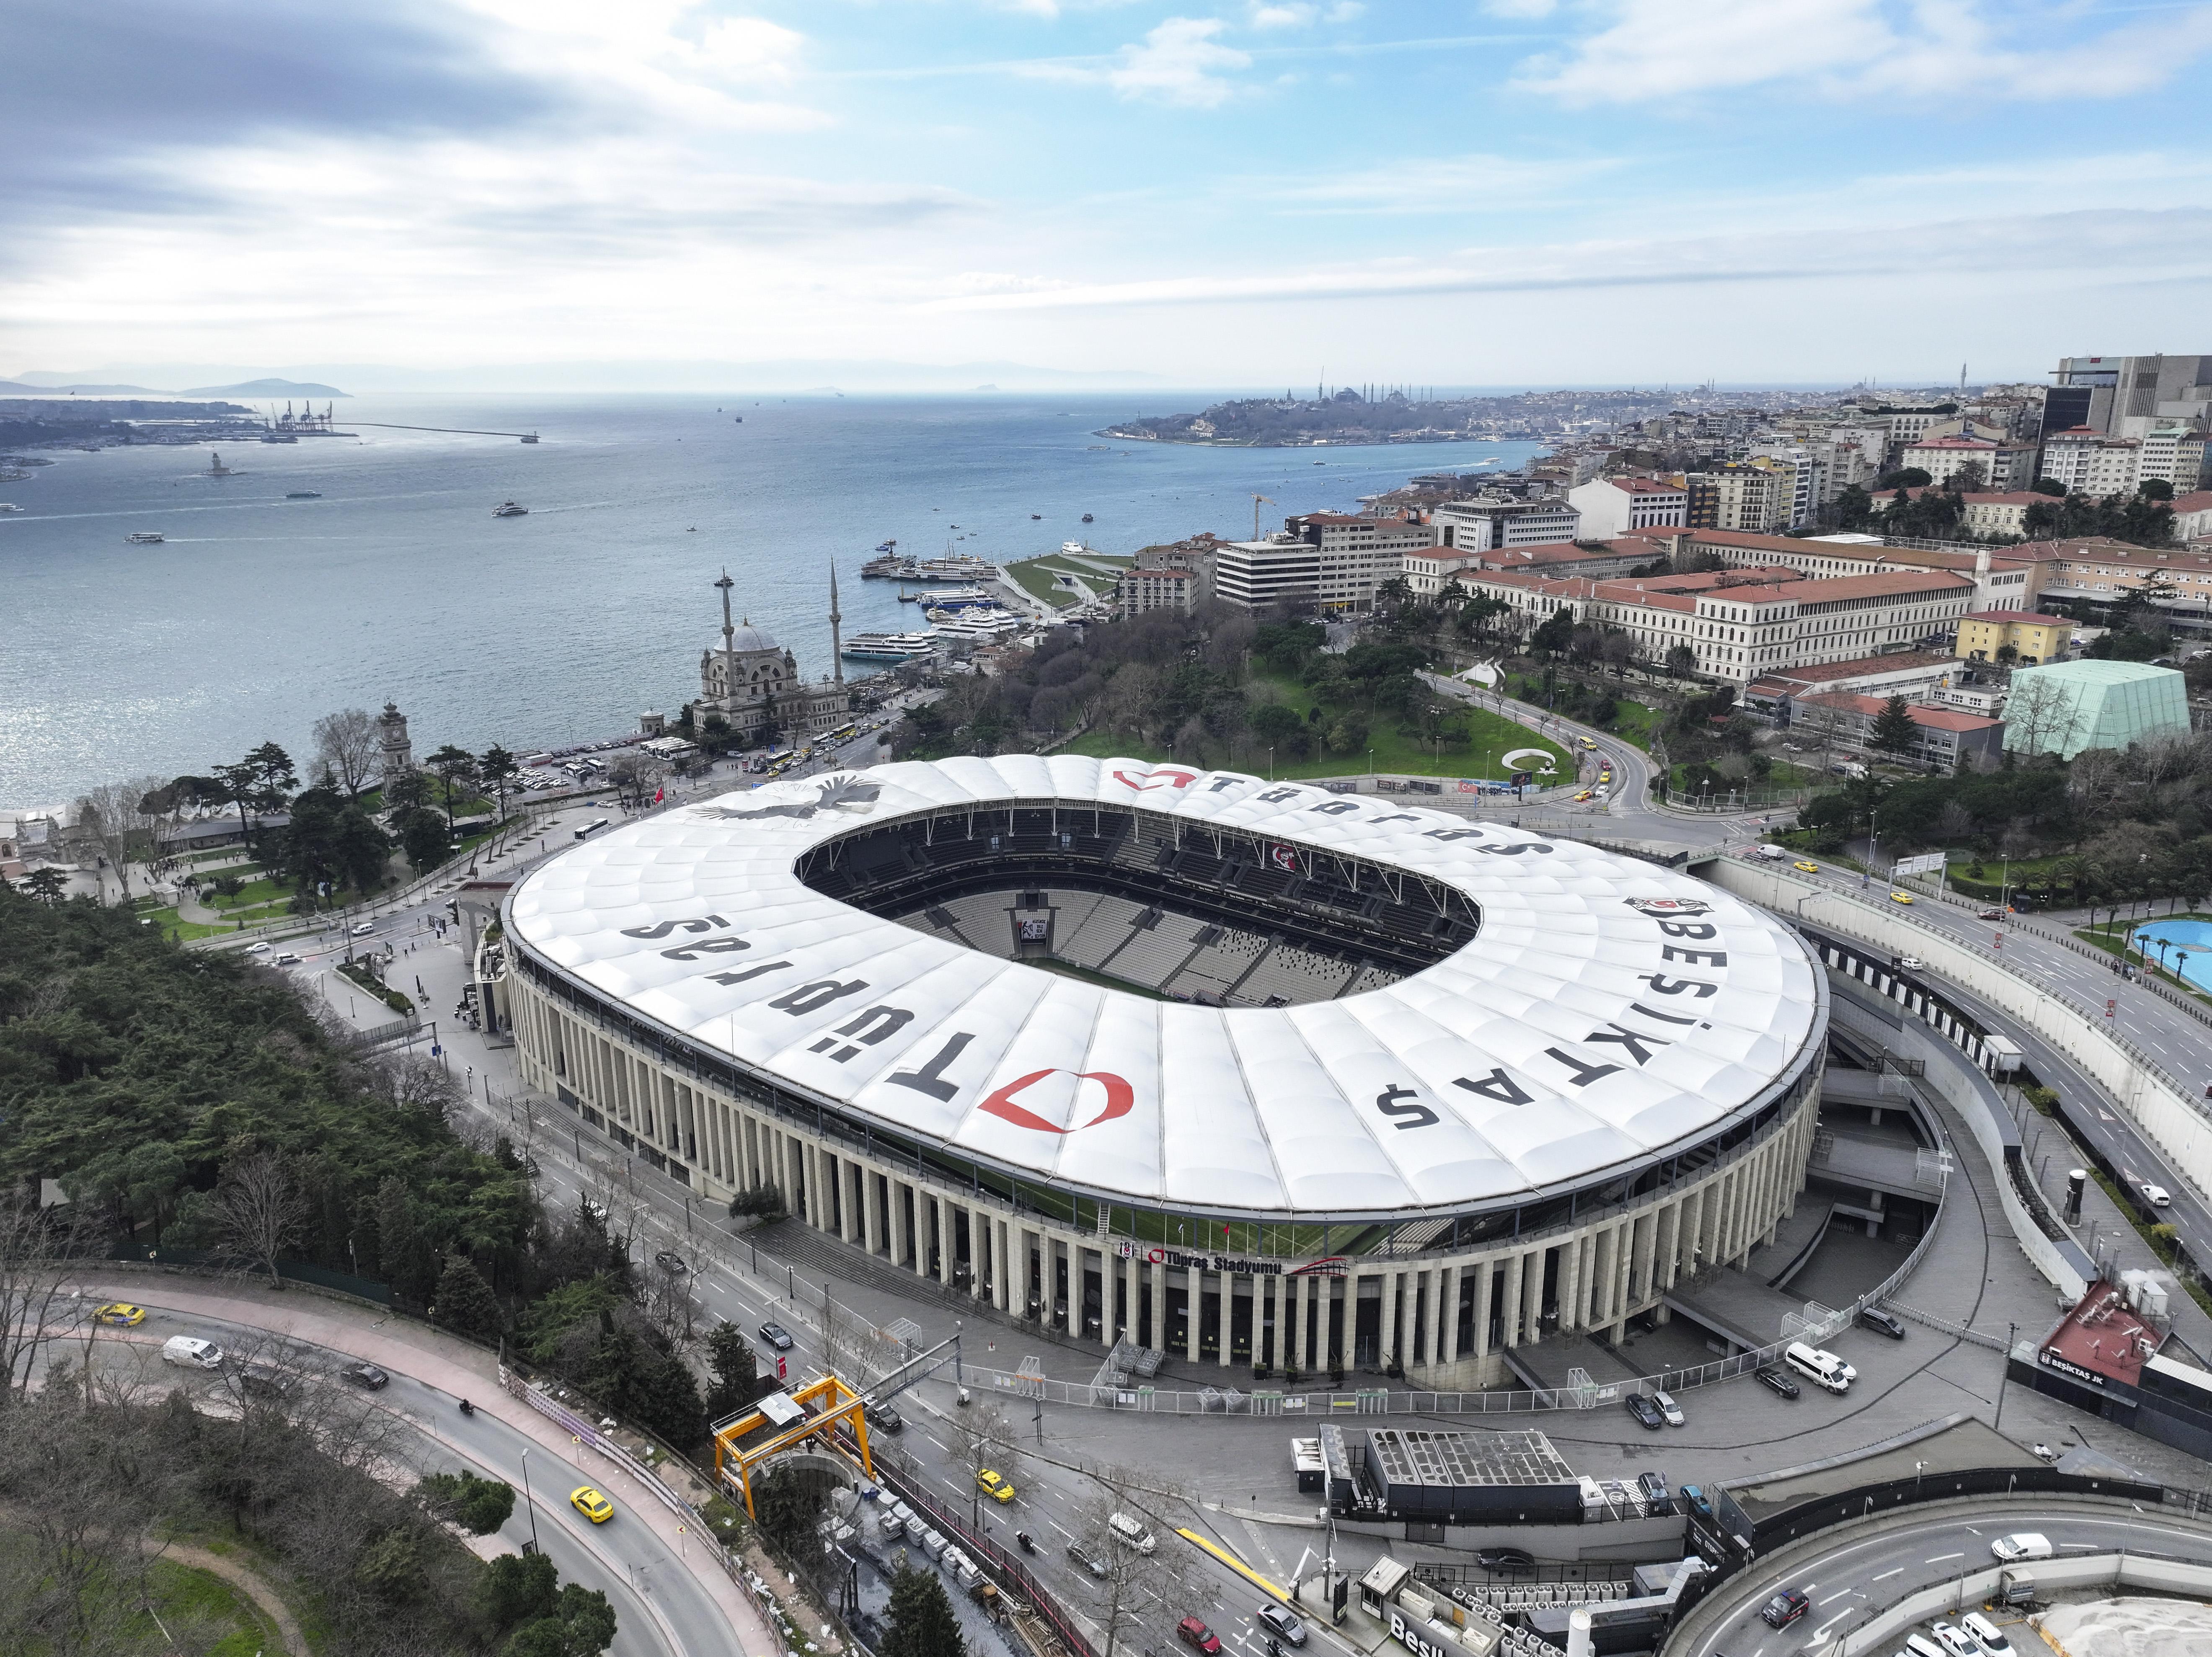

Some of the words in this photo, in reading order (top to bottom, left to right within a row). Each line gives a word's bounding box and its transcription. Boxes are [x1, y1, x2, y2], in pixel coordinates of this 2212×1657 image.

[620, 914, 977, 1102] Tüpraş
[1377, 919, 1727, 1130] BEŞİKTAŞ
[1165, 1251, 1208, 1270] Tüpraş
[1215, 1257, 1282, 1274] Stadyumu
[2052, 1359, 2090, 1380] BEŞİKTAŞ
[2092, 1376, 2103, 1385] JK
